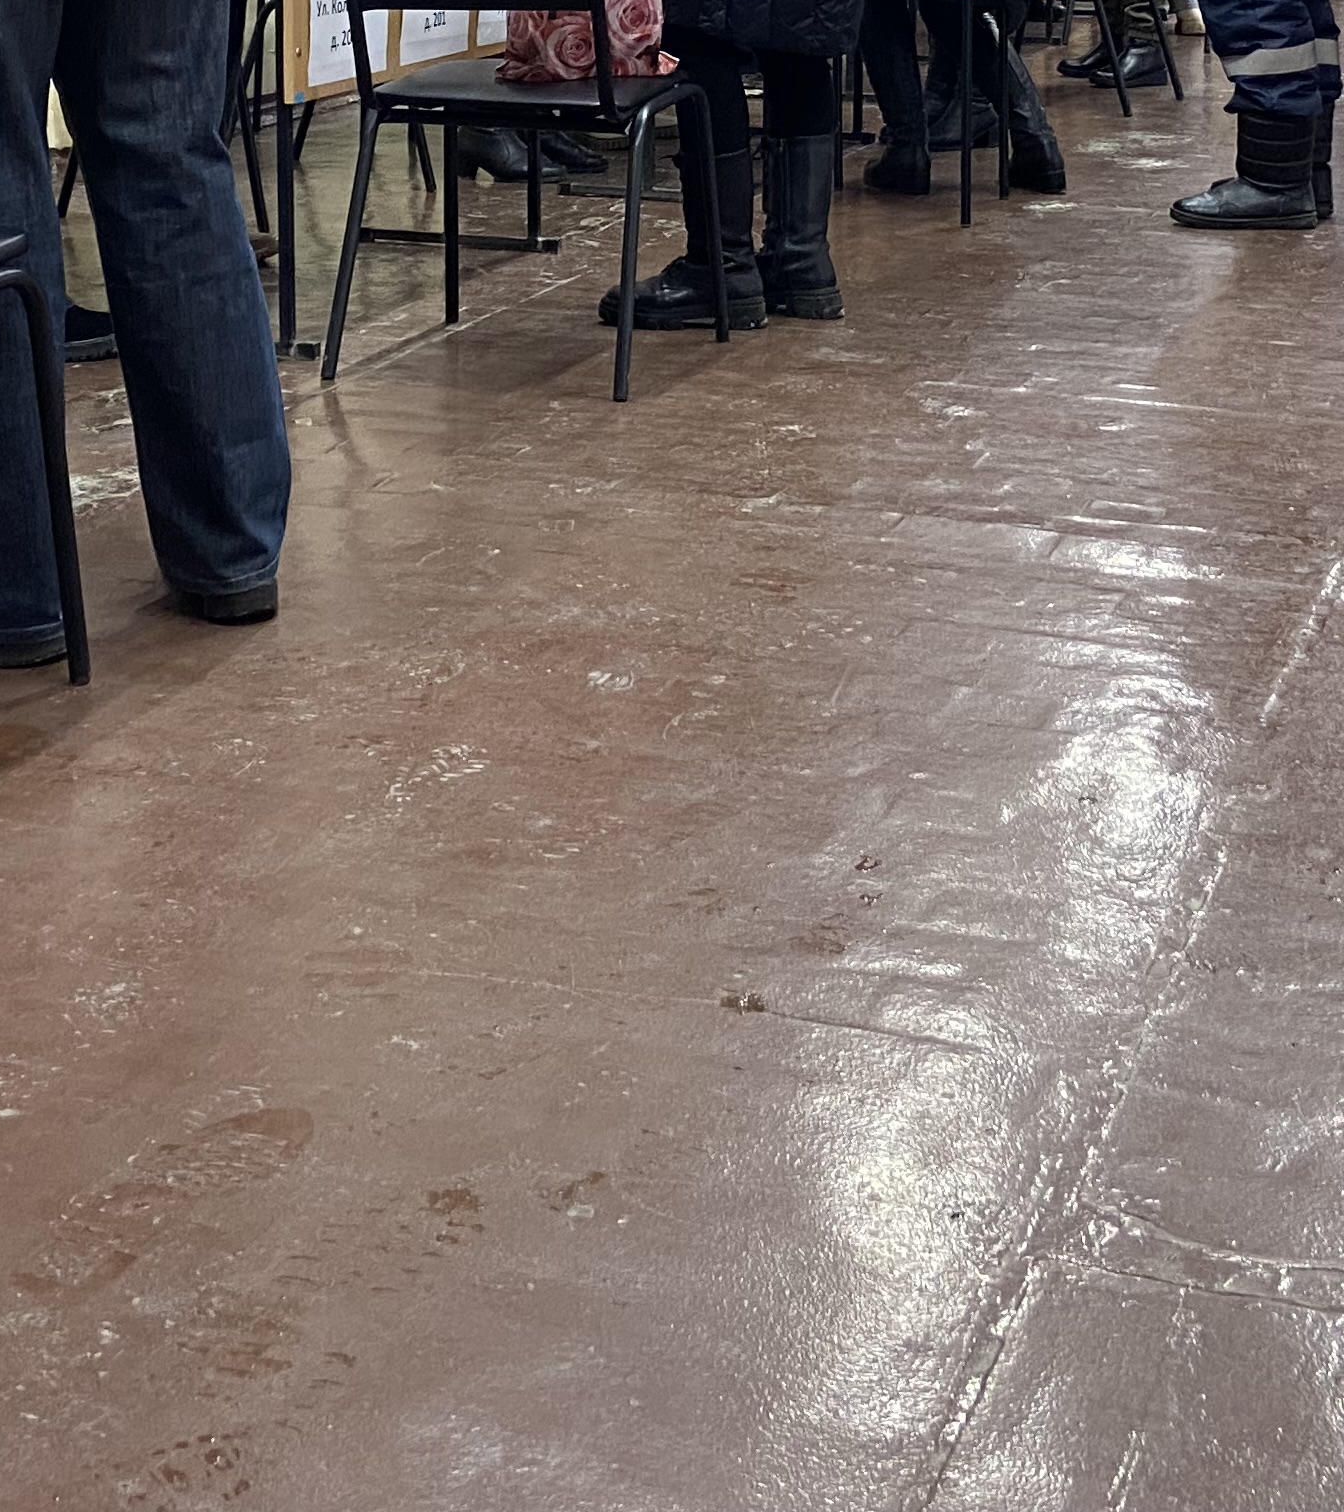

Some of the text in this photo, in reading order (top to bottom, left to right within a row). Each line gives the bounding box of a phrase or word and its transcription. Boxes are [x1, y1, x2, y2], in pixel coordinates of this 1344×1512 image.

[316, 0, 330, 17] Ул.
[433, 11, 447, 28] 201
[330, 35, 340, 53] д.
